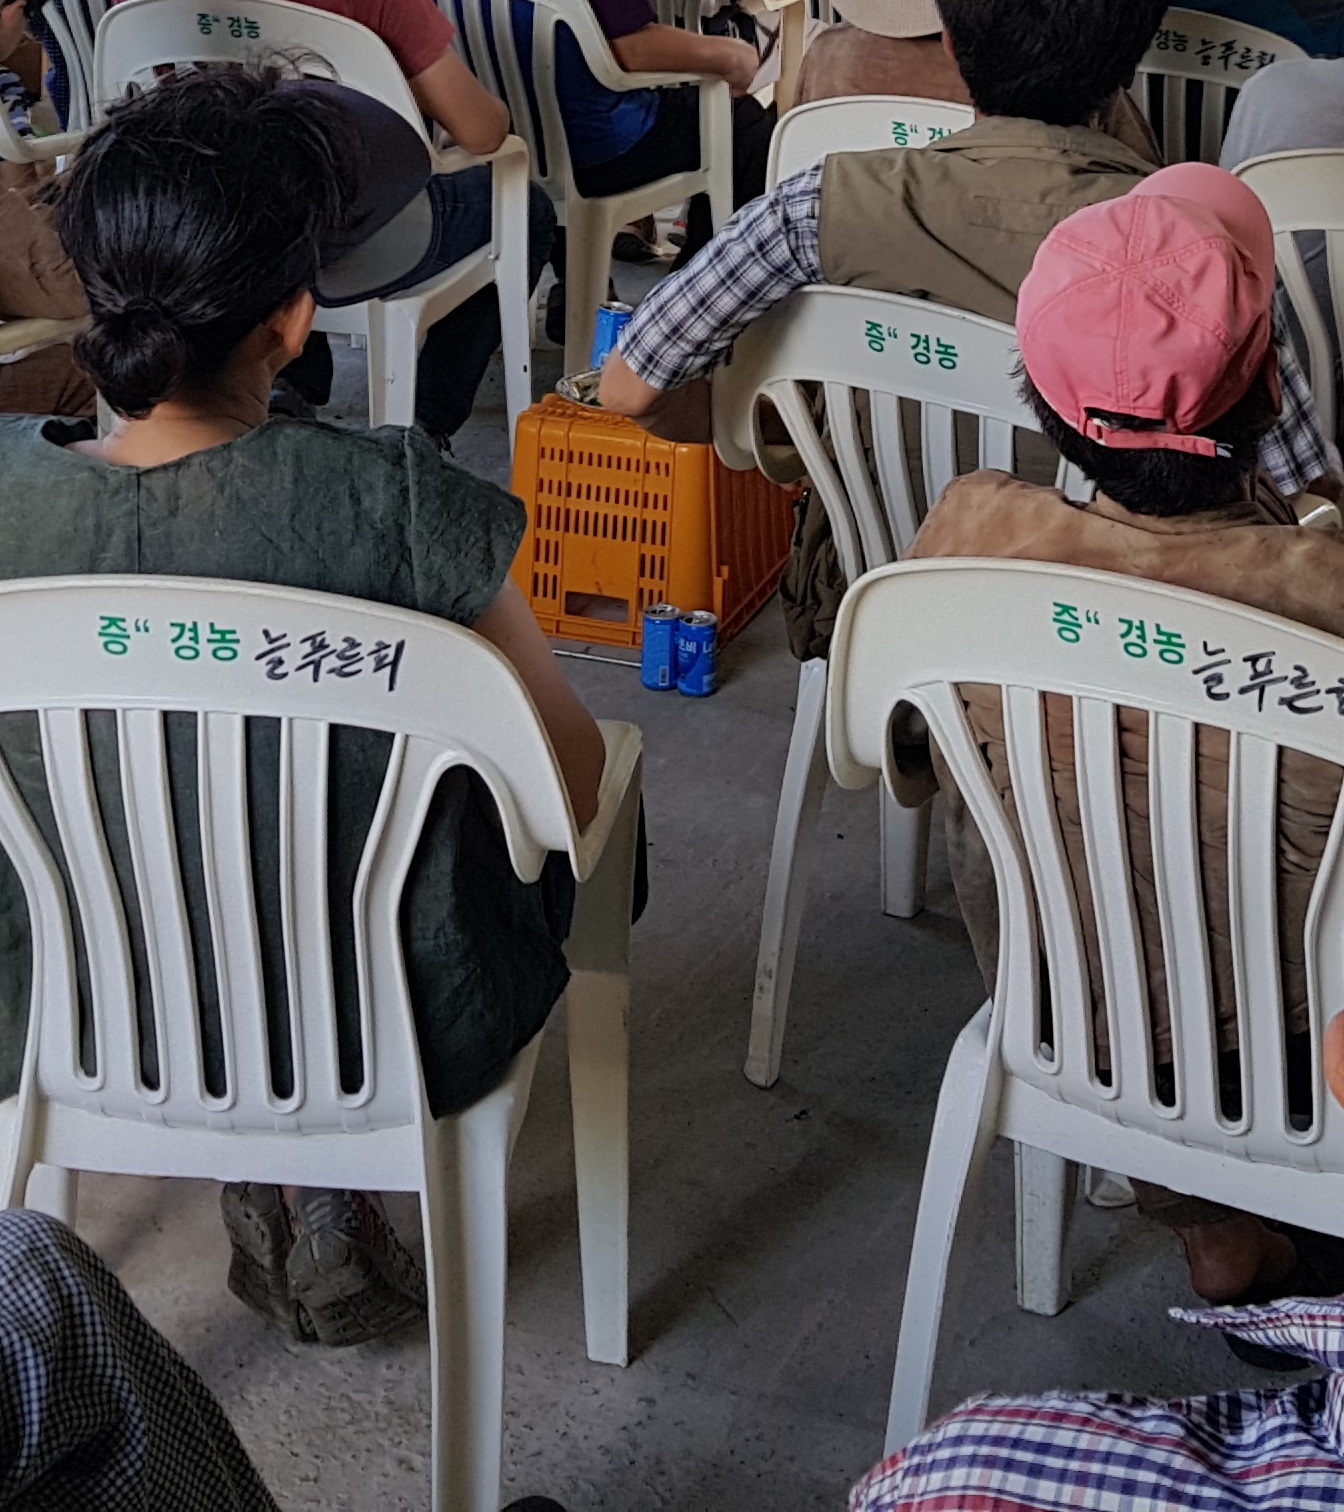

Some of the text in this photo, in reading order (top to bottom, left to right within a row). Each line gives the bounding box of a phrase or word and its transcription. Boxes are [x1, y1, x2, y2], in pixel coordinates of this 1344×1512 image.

[226, 16, 262, 39] 경농
[909, 332, 959, 371] 경농
[168, 620, 241, 662] 경농
[254, 627, 407, 693] 늘푸른회
[1117, 616, 1188, 666] 경농
